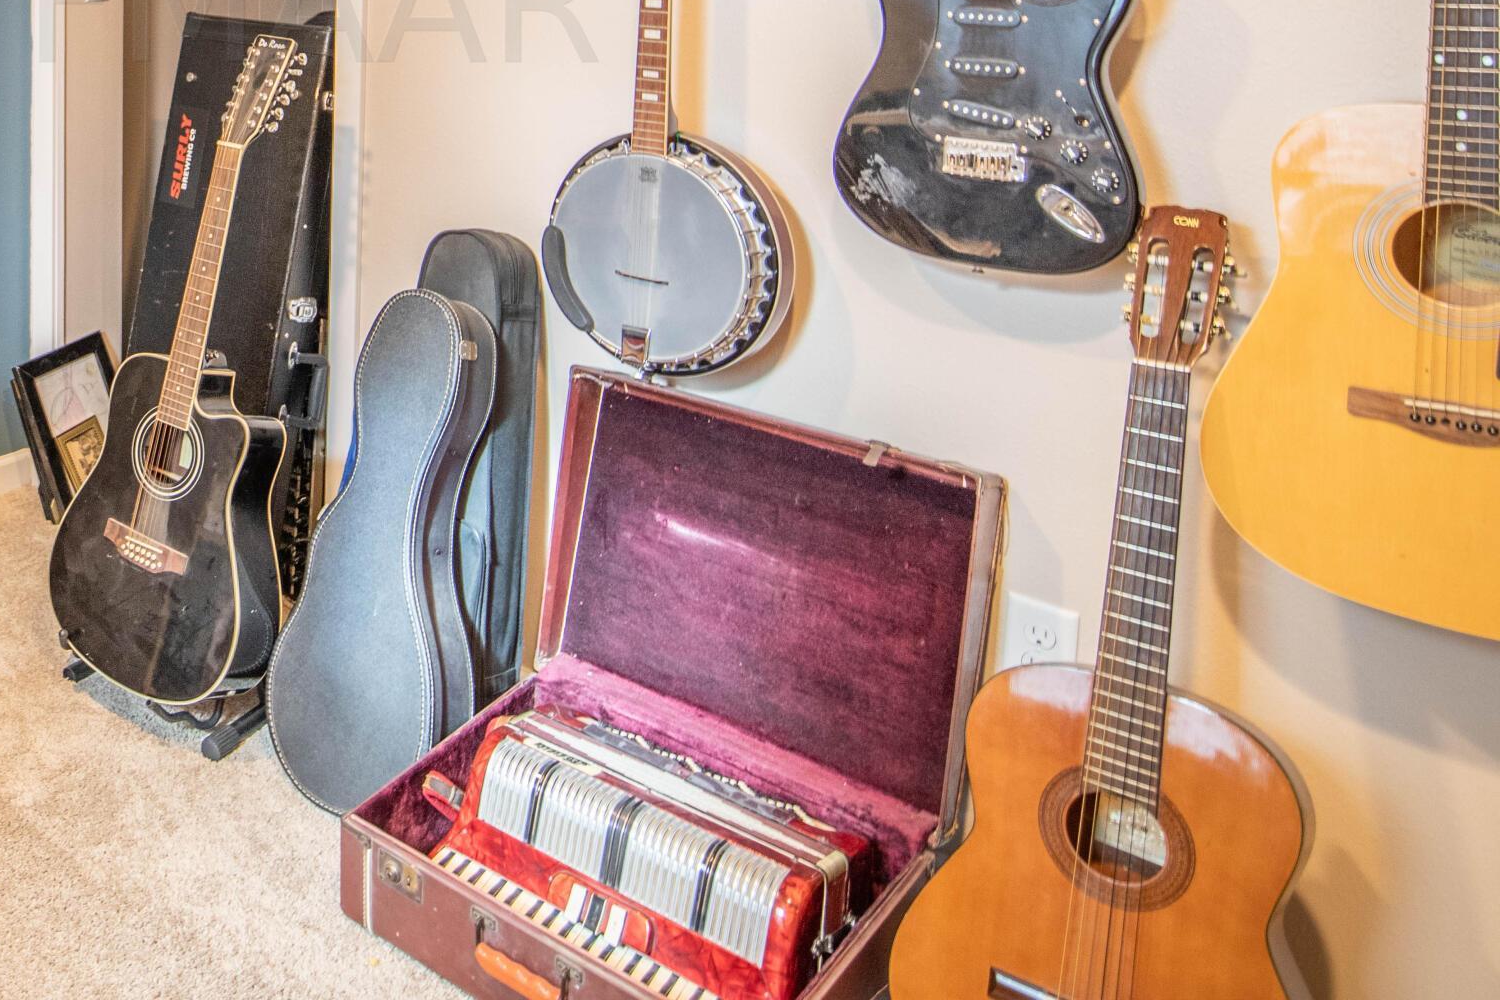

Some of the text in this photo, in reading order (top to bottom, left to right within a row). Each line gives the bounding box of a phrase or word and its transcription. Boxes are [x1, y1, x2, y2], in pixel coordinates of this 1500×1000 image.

[169, 112, 192, 200] SURLY
[181, 143, 194, 190] BREWING
[1173, 215, 1200, 229] CONN
